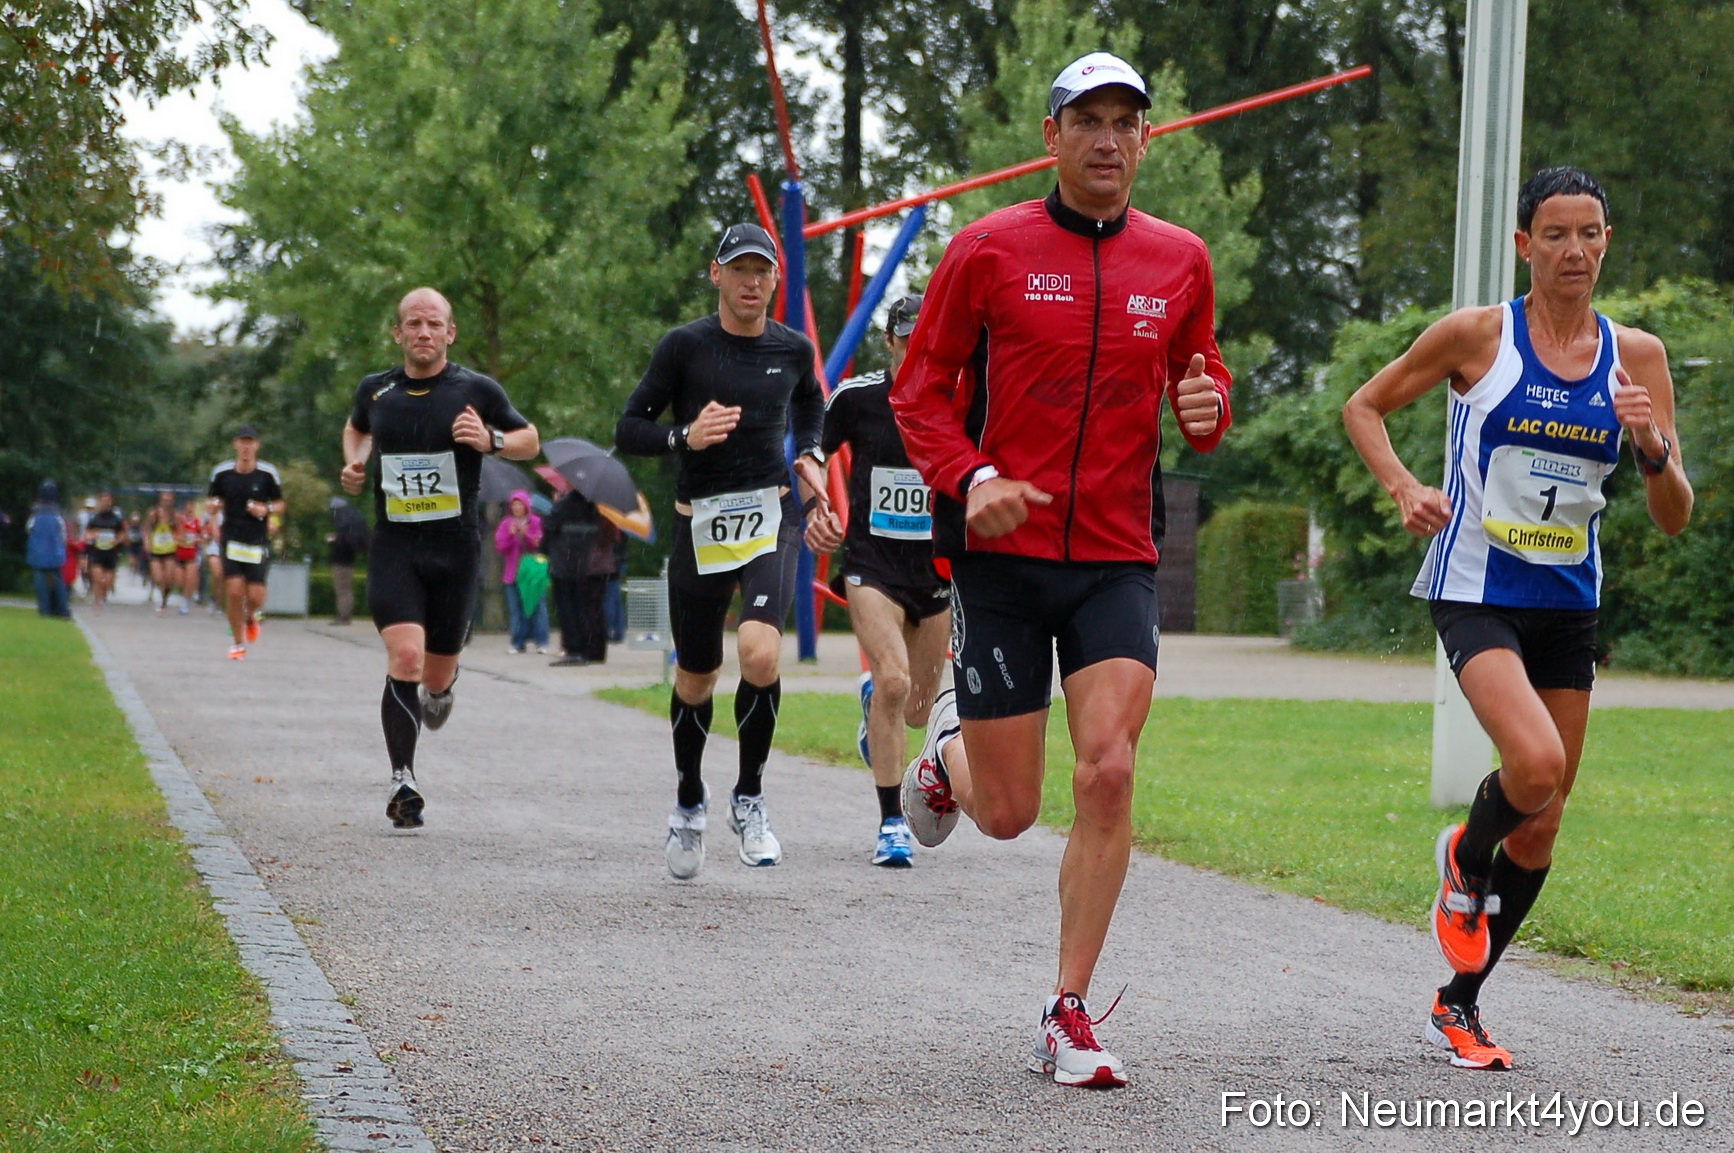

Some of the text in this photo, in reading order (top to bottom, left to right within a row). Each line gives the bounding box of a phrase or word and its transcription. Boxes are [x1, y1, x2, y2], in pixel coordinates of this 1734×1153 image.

[1028, 273, 1070, 291] HDI
[1127, 294, 1167, 313] ARNDT
[1526, 384, 1570, 403] HEITEC
[1507, 417, 1609, 444] LAC QUELLE
[1532, 458, 1582, 478] BOCK
[397, 472, 443, 496] 112
[405, 501, 437, 513] Stefan
[1540, 485, 1558, 521] 1
[711, 512, 764, 542] 672
[888, 517, 926, 530] Richard
[1508, 528, 1574, 549] Christine
